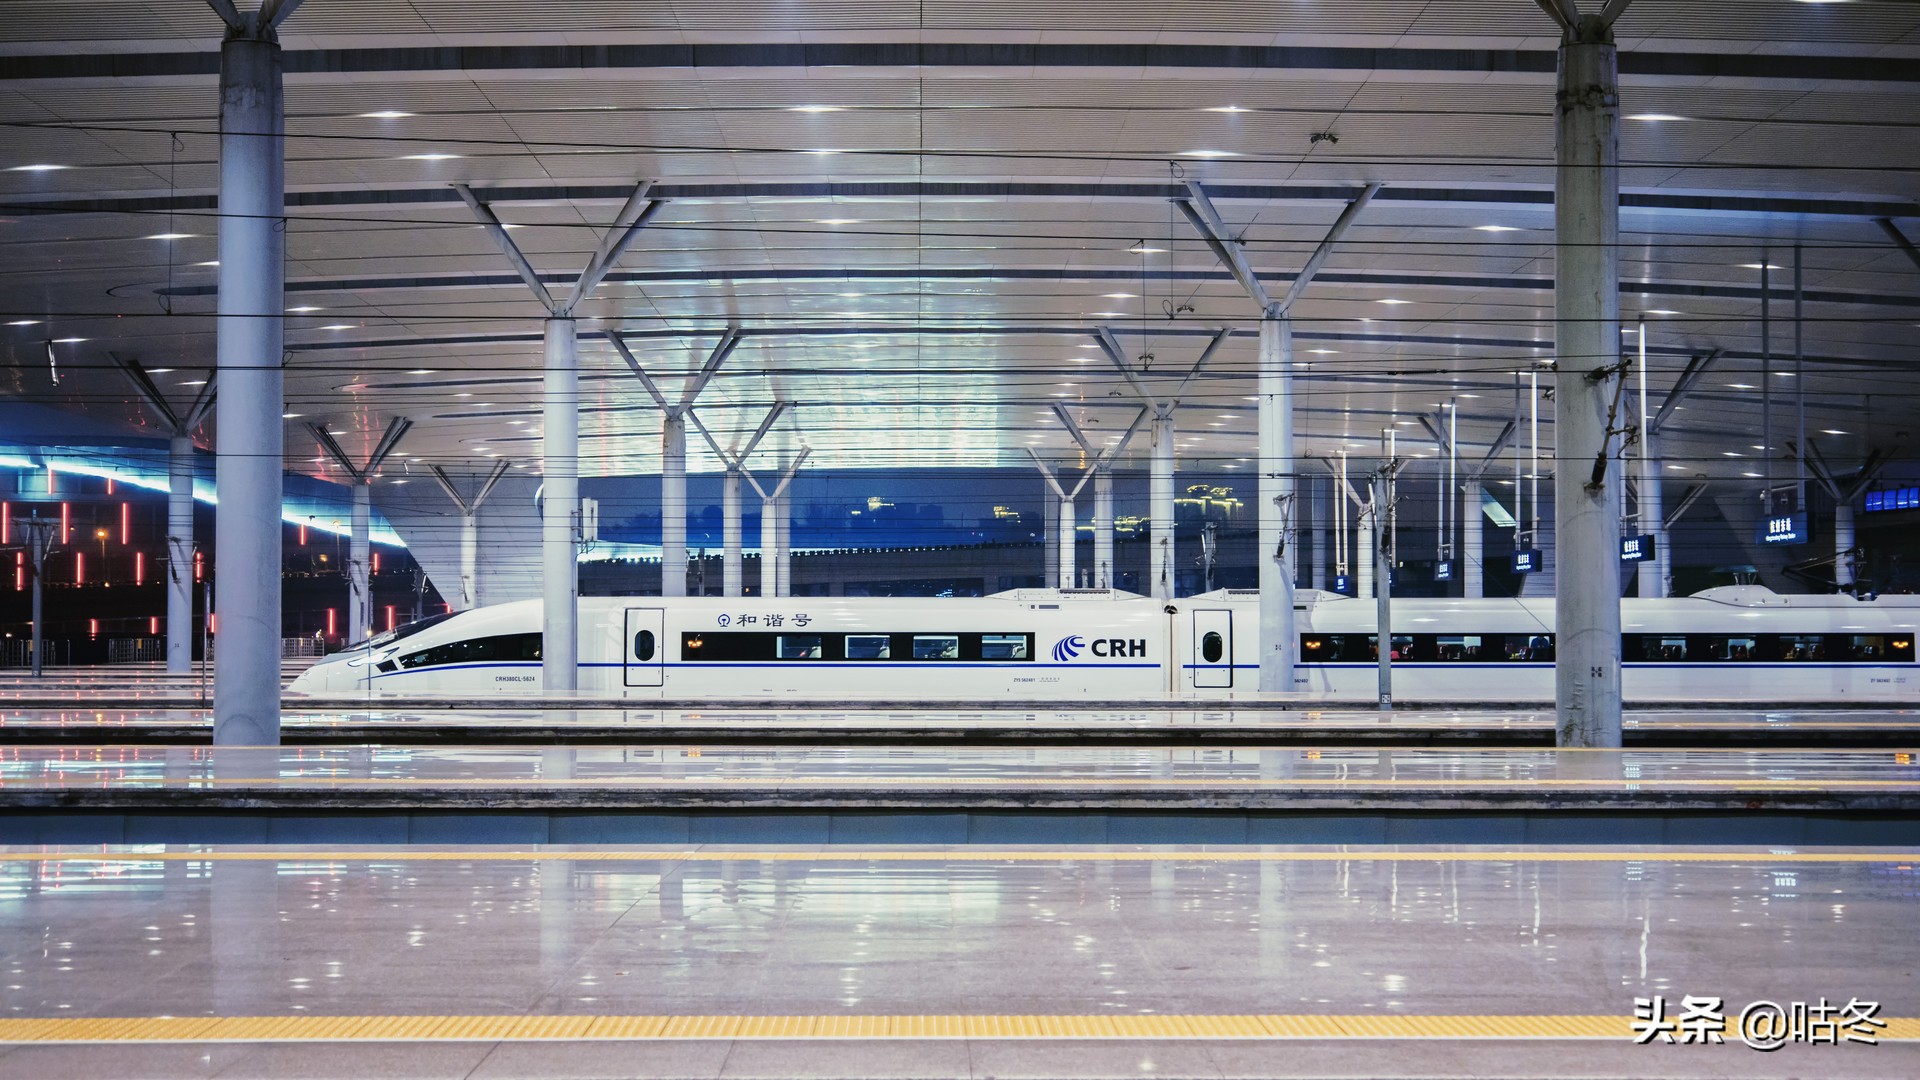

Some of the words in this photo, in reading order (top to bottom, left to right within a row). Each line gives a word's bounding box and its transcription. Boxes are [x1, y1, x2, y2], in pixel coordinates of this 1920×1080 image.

[736, 613, 812, 627] 和谐号
[1091, 638, 1146, 657] CRH
